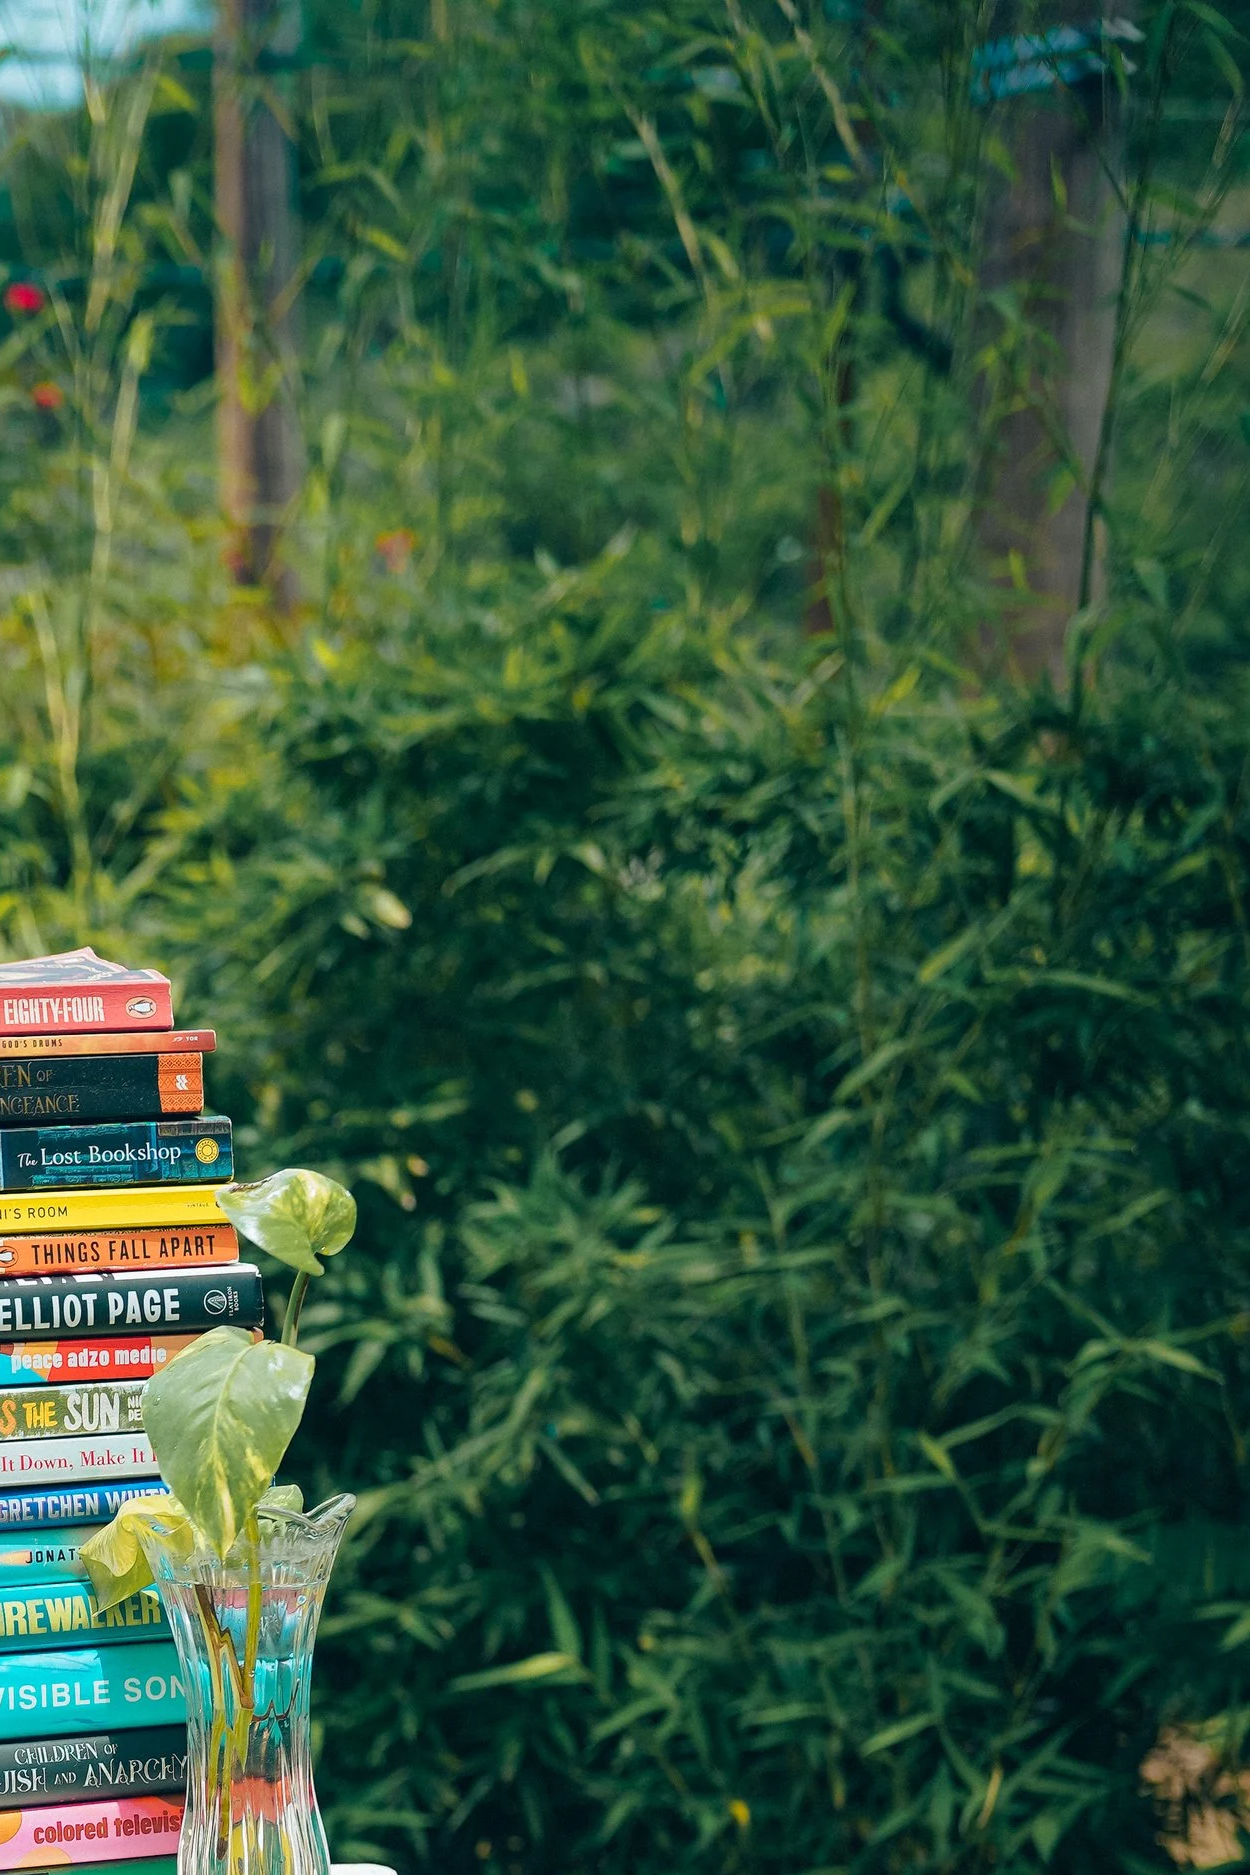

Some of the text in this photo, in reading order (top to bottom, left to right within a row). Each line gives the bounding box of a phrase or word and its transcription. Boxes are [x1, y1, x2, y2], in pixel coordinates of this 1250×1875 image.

[3, 996, 105, 1025] EIGHTY-FOUR
[2, 1040, 28, 1048] GOD'S
[33, 1038, 63, 1047] DRUMS
[36, 1068, 54, 1082] OF
[17, 1152, 38, 1168] The
[41, 1147, 82, 1166] Lost
[88, 1141, 181, 1165] Bookshop
[28, 1206, 68, 1218] ROOM
[31, 1234, 215, 1265] THINGS FALL APART
[108, 1288, 180, 1325] PAGE
[11, 1345, 167, 1374] peace adzo medie
[22, 1401, 58, 1429] THE
[63, 1392, 120, 1432] SUN
[1, 1455, 15, 1473] It
[19, 1454, 74, 1471] Down,
[80, 1449, 125, 1467] Make
[132, 1447, 145, 1463] It
[25, 1548, 81, 1564] JONAT
[14, 1740, 119, 1766] CHILDREN OF
[54, 1771, 77, 1785] AND
[83, 1753, 188, 1788] ANARCHY
[33, 1817, 109, 1845] colored
